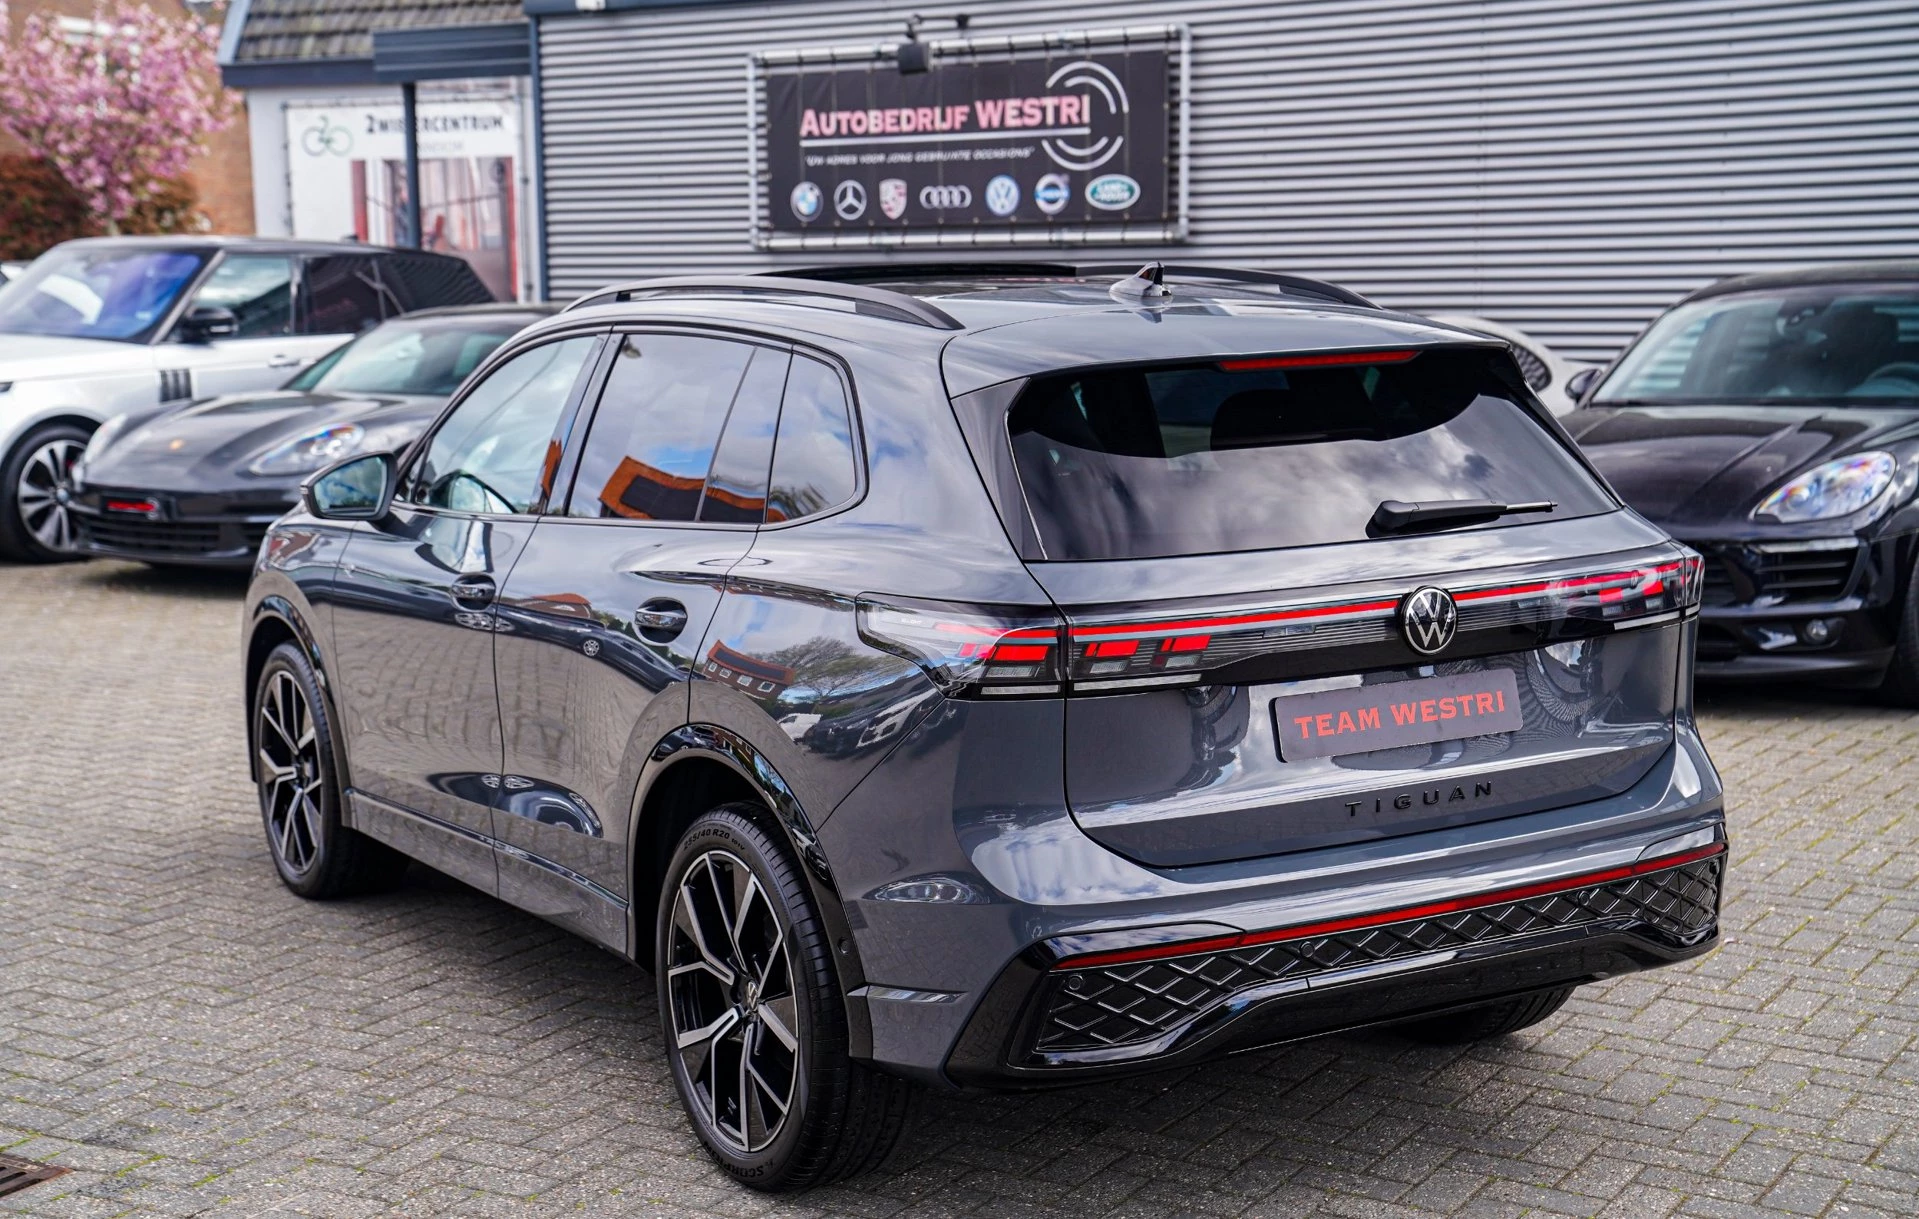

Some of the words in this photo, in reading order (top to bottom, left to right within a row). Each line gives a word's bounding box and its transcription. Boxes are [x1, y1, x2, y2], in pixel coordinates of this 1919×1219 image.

[800, 105, 970, 137] AUTOBEDRIJF
[974, 94, 1091, 129] WESTRI
[1294, 706, 1382, 740] TEAM
[1390, 690, 1506, 726] WESTRI
[1344, 780, 1493, 817] TIGUAN
[712, 828, 731, 840] R20
